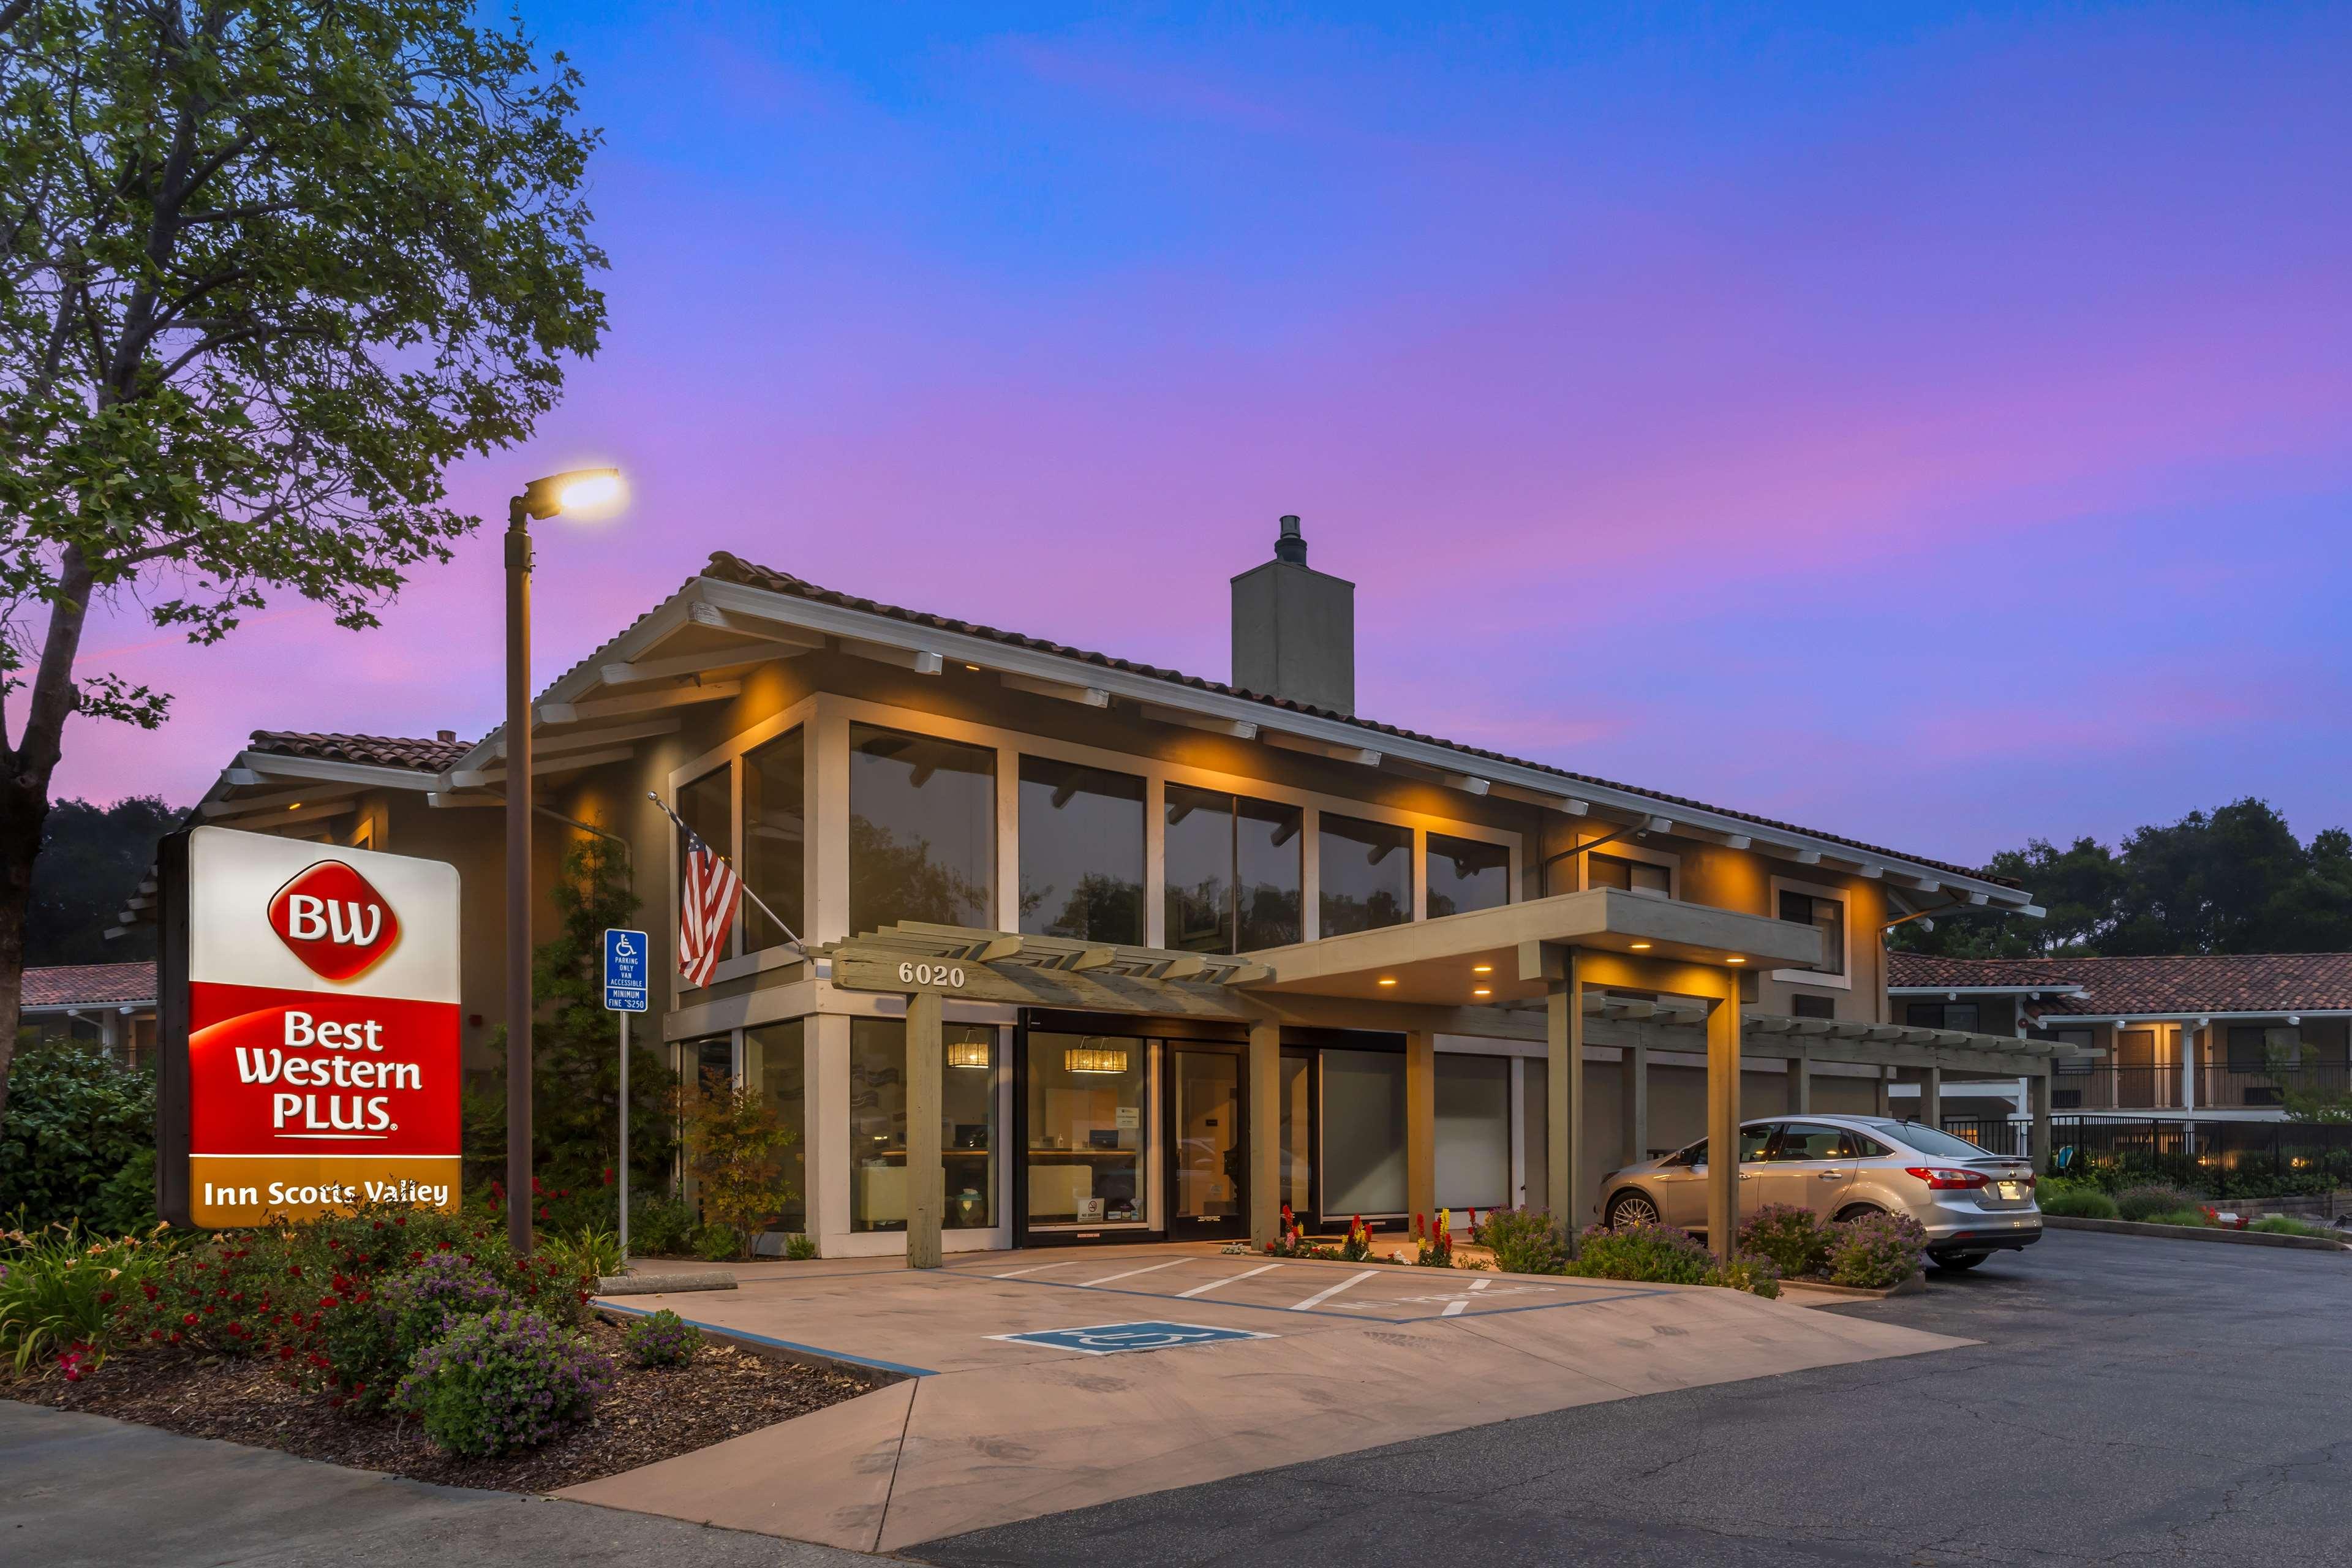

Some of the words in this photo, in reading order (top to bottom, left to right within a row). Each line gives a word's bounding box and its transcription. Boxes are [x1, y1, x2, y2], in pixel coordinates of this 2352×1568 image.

[289, 894, 382, 946] BW
[899, 962, 965, 988] 6020
[613, 990, 639, 998] MINIMUM
[627, 1000, 644, 1008] $250
[284, 1011, 383, 1051] Best
[235, 1047, 423, 1090] Western
[274, 1093, 390, 1131] PLUS
[205, 1183, 258, 1205] Inn
[268, 1182, 356, 1205] Scotts
[364, 1180, 449, 1207] Valley
[1323, 1300, 1400, 1310] NO
[1394, 1286, 1556, 1303] PARKING
